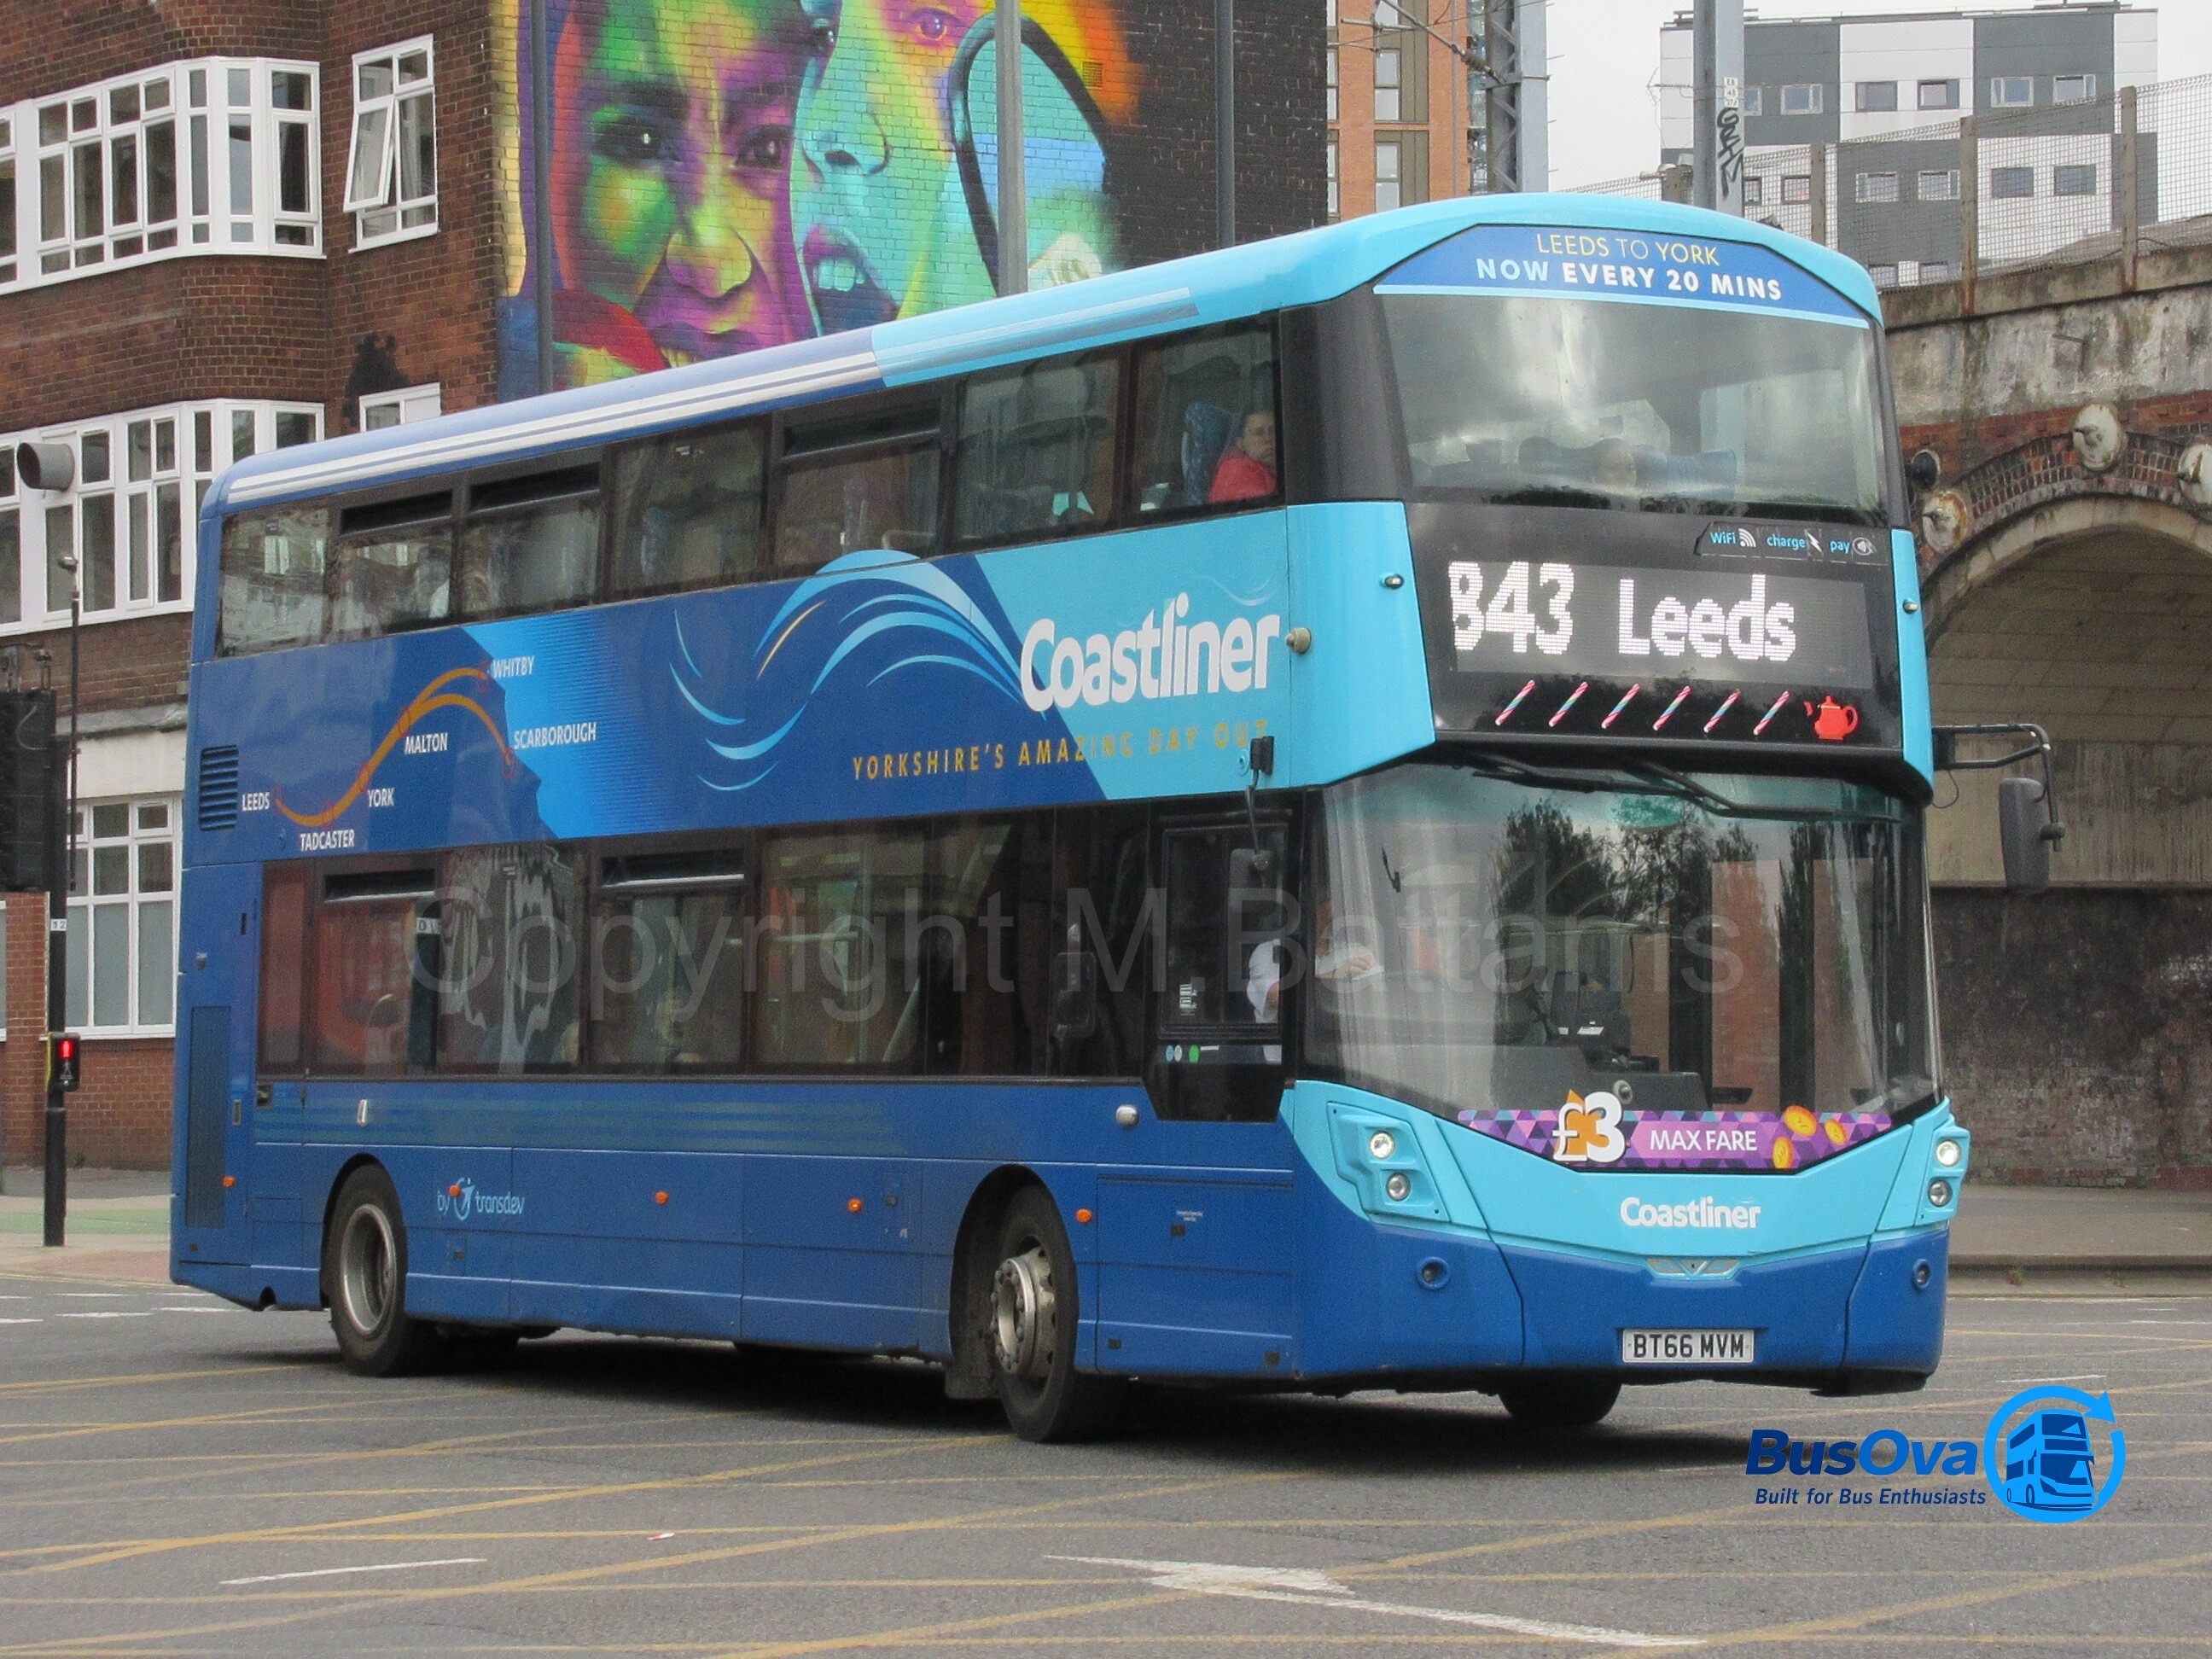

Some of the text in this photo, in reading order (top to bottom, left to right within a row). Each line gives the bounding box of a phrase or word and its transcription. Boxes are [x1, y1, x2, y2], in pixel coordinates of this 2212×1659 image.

[1537, 233, 1720, 266] LEEDS TO YORK
[1476, 259, 1781, 301] NOW EVERY 20 MINS
[1710, 531, 1851, 553] WiFi charge pay
[1617, 573, 1796, 662] Leeds
[1019, 591, 1280, 713] Coastliner
[492, 655, 535, 679] WHITBY
[404, 732, 449, 755] MALTON
[514, 722, 597, 750] SCARBOROUGH
[853, 719, 1267, 781] YORKSHIRE'S AMAZING DAY OUT
[242, 791, 271, 812] LEEDS
[367, 787, 395, 807] YORK
[300, 829, 356, 853] TADCASTER
[1552, 1091, 1626, 1163] £3
[1650, 1129, 1758, 1152] MAX FARE
[437, 1190, 525, 1216] by transdev
[1621, 1196, 1761, 1229] Coastliner
[1633, 1334, 1744, 1359] BT66 MVM
